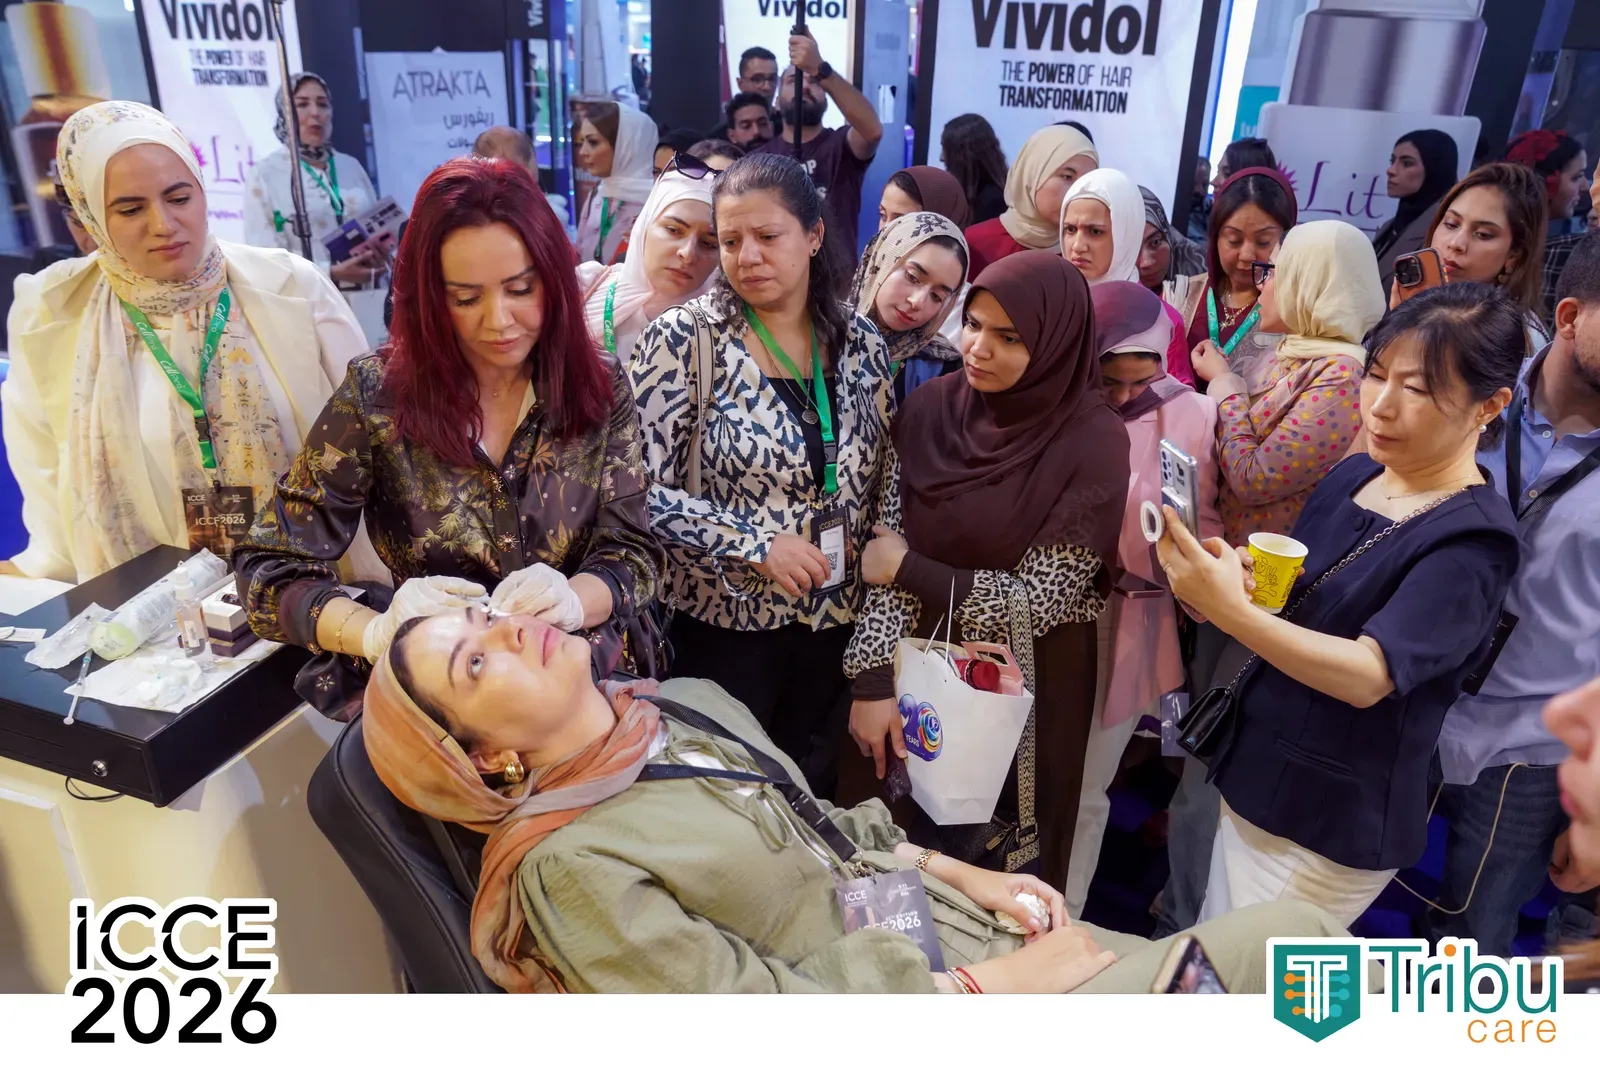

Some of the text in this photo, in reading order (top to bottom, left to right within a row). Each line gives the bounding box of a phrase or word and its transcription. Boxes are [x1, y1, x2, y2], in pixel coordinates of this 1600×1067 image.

[757, 0, 847, 18] Vivdol
[971, 0, 1162, 56] Vividol
[392, 70, 492, 102] ATRAKTA
[1001, 60, 1132, 87] THE POWER OF HAIR
[999, 84, 1128, 114] TRANSFORMATION
[844, 889, 868, 902] ICCE
